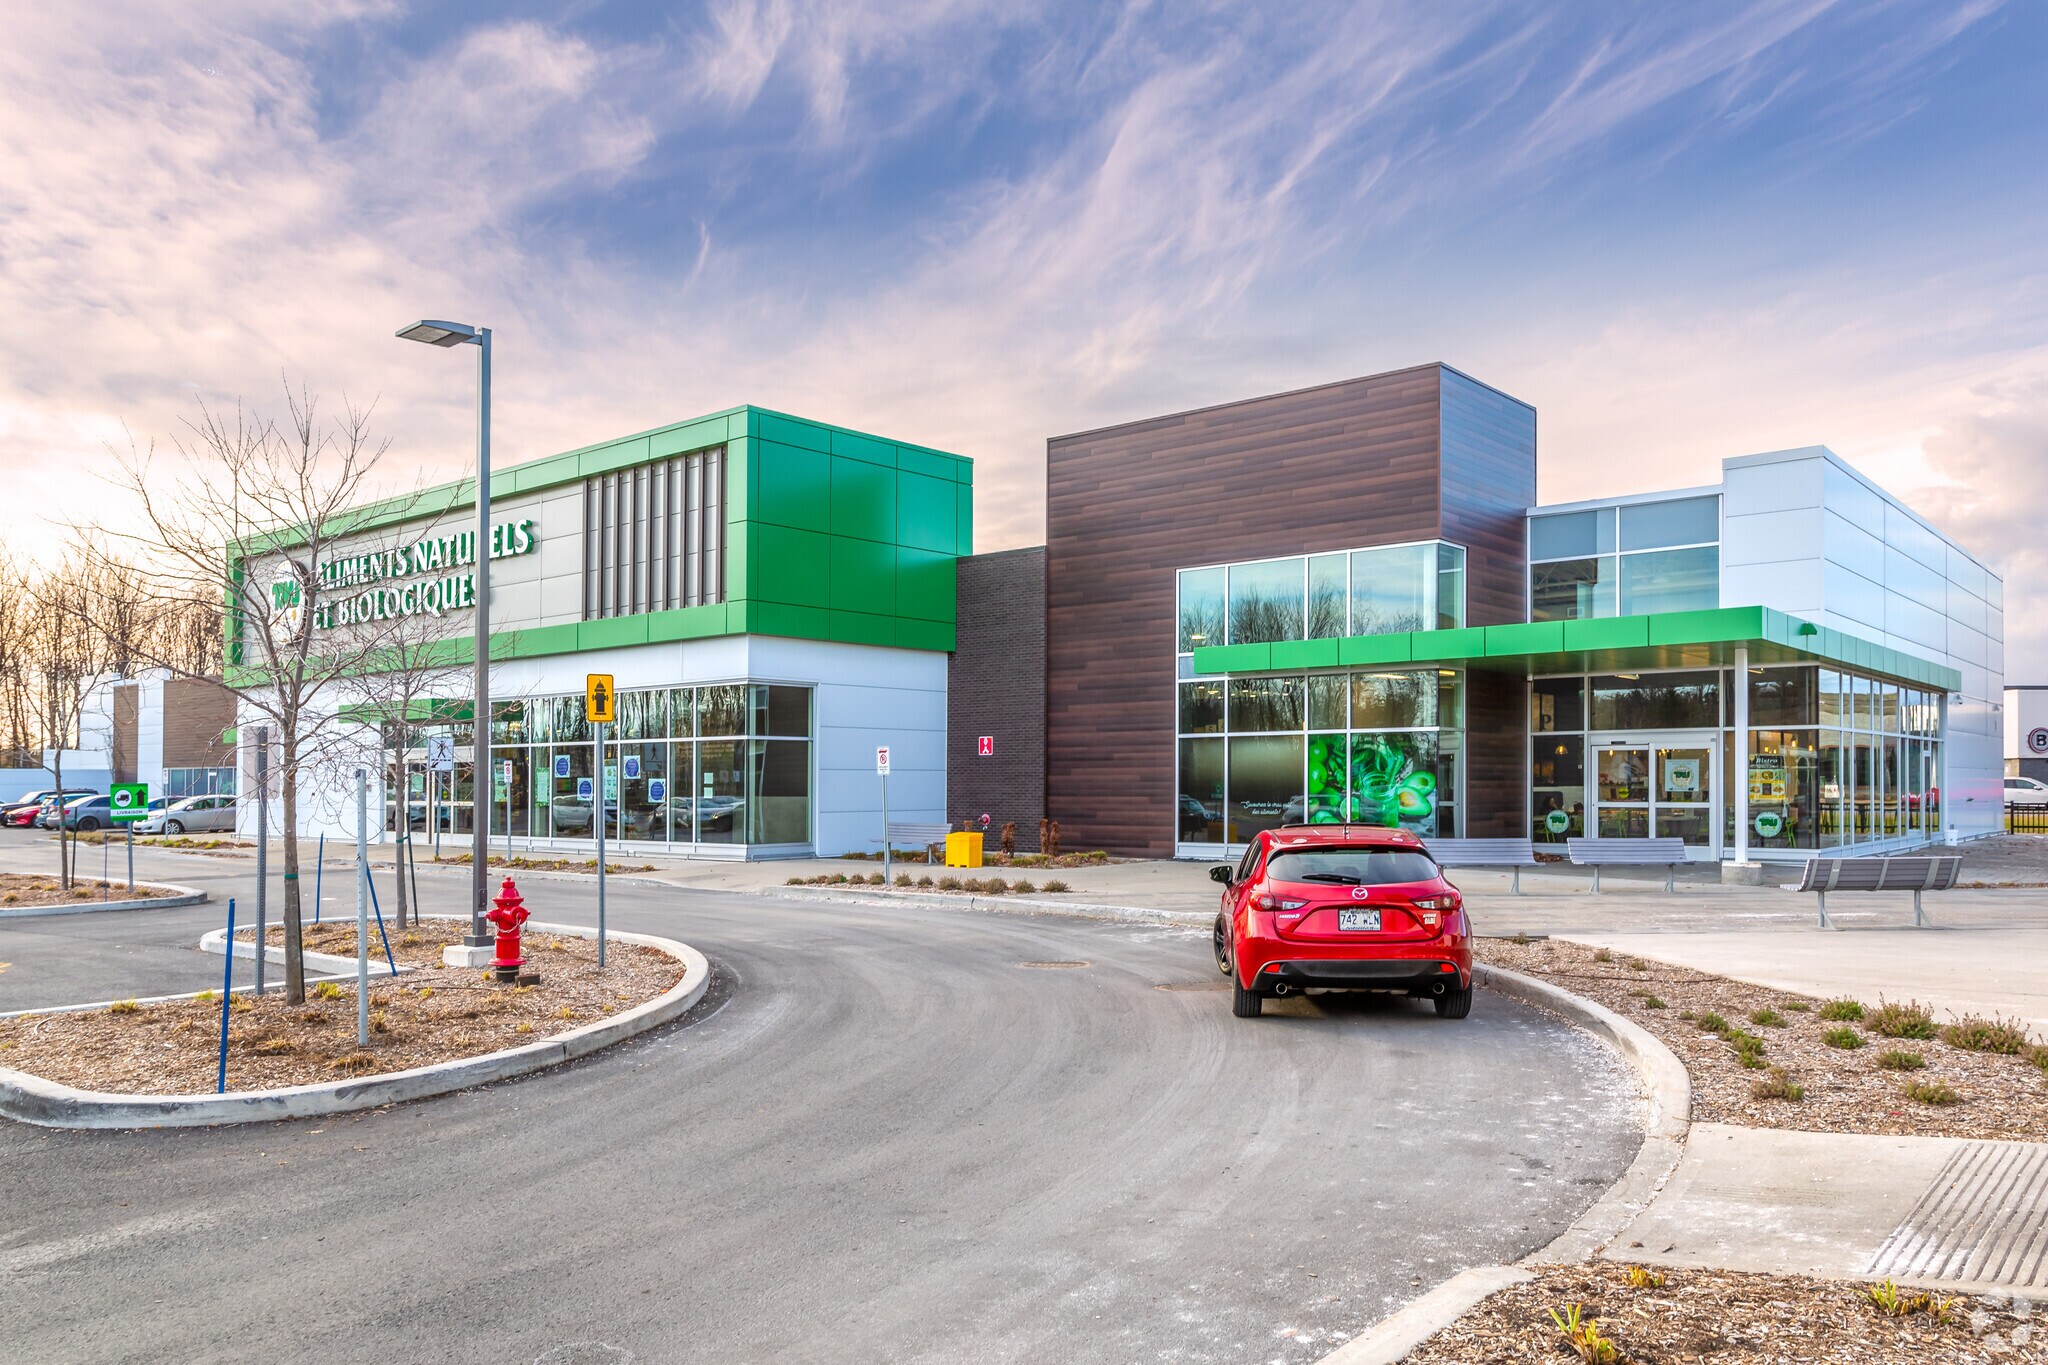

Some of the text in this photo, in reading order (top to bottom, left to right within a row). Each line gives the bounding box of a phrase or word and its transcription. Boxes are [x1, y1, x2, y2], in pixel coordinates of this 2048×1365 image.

[413, 519, 532, 573] NATUELS
[313, 600, 332, 630] ET
[1340, 914, 1357, 925] 742
